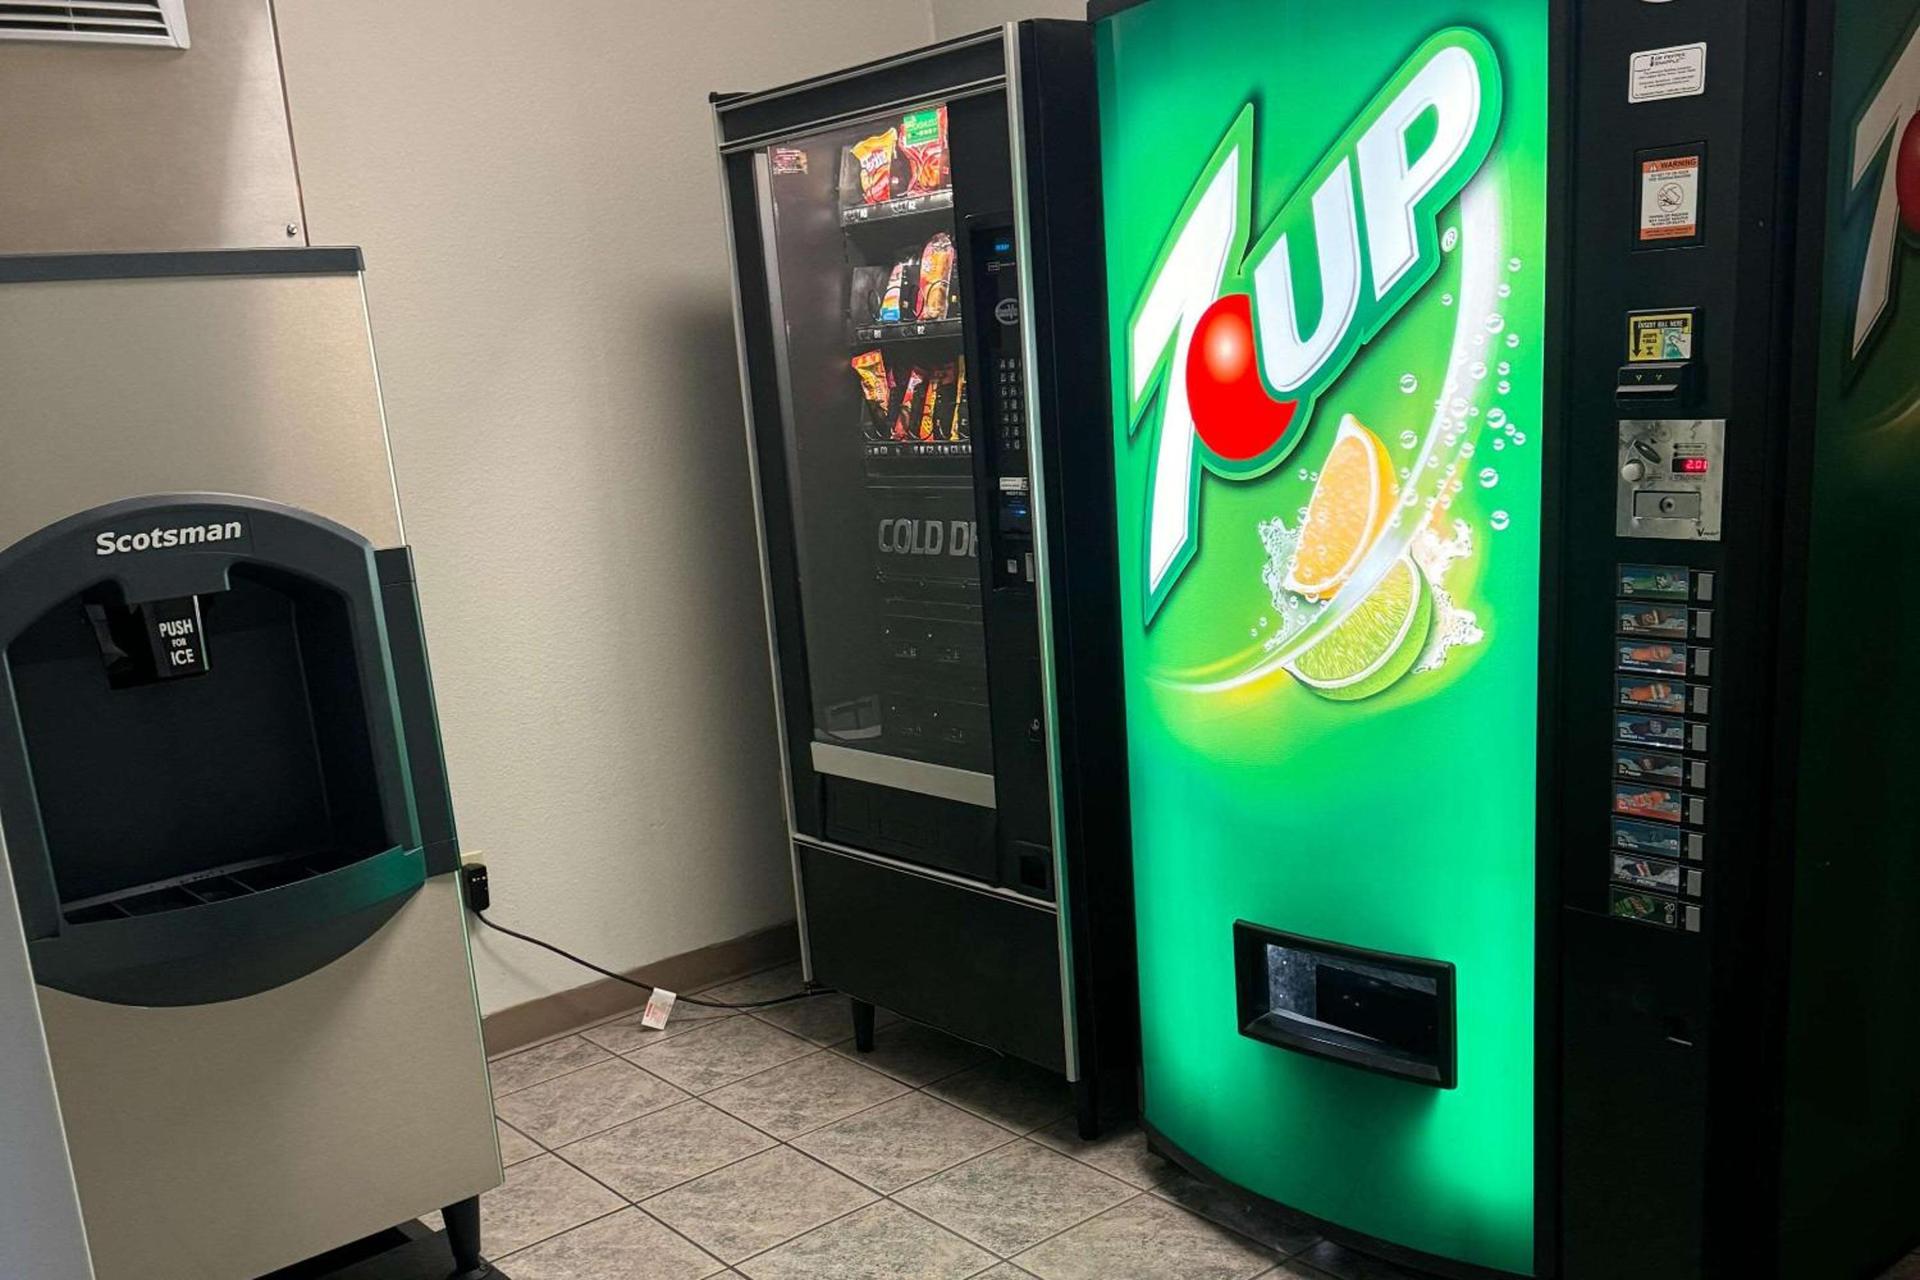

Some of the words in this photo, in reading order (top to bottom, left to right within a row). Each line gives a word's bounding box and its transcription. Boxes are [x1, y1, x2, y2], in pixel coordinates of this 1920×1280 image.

[1661, 158, 1697, 170] WARNING
[95, 519, 242, 556] Scotsman
[878, 518, 944, 556] COLD
[158, 618, 194, 638] PUSH
[171, 638, 187, 648] FOR
[169, 648, 195, 666] ICE
